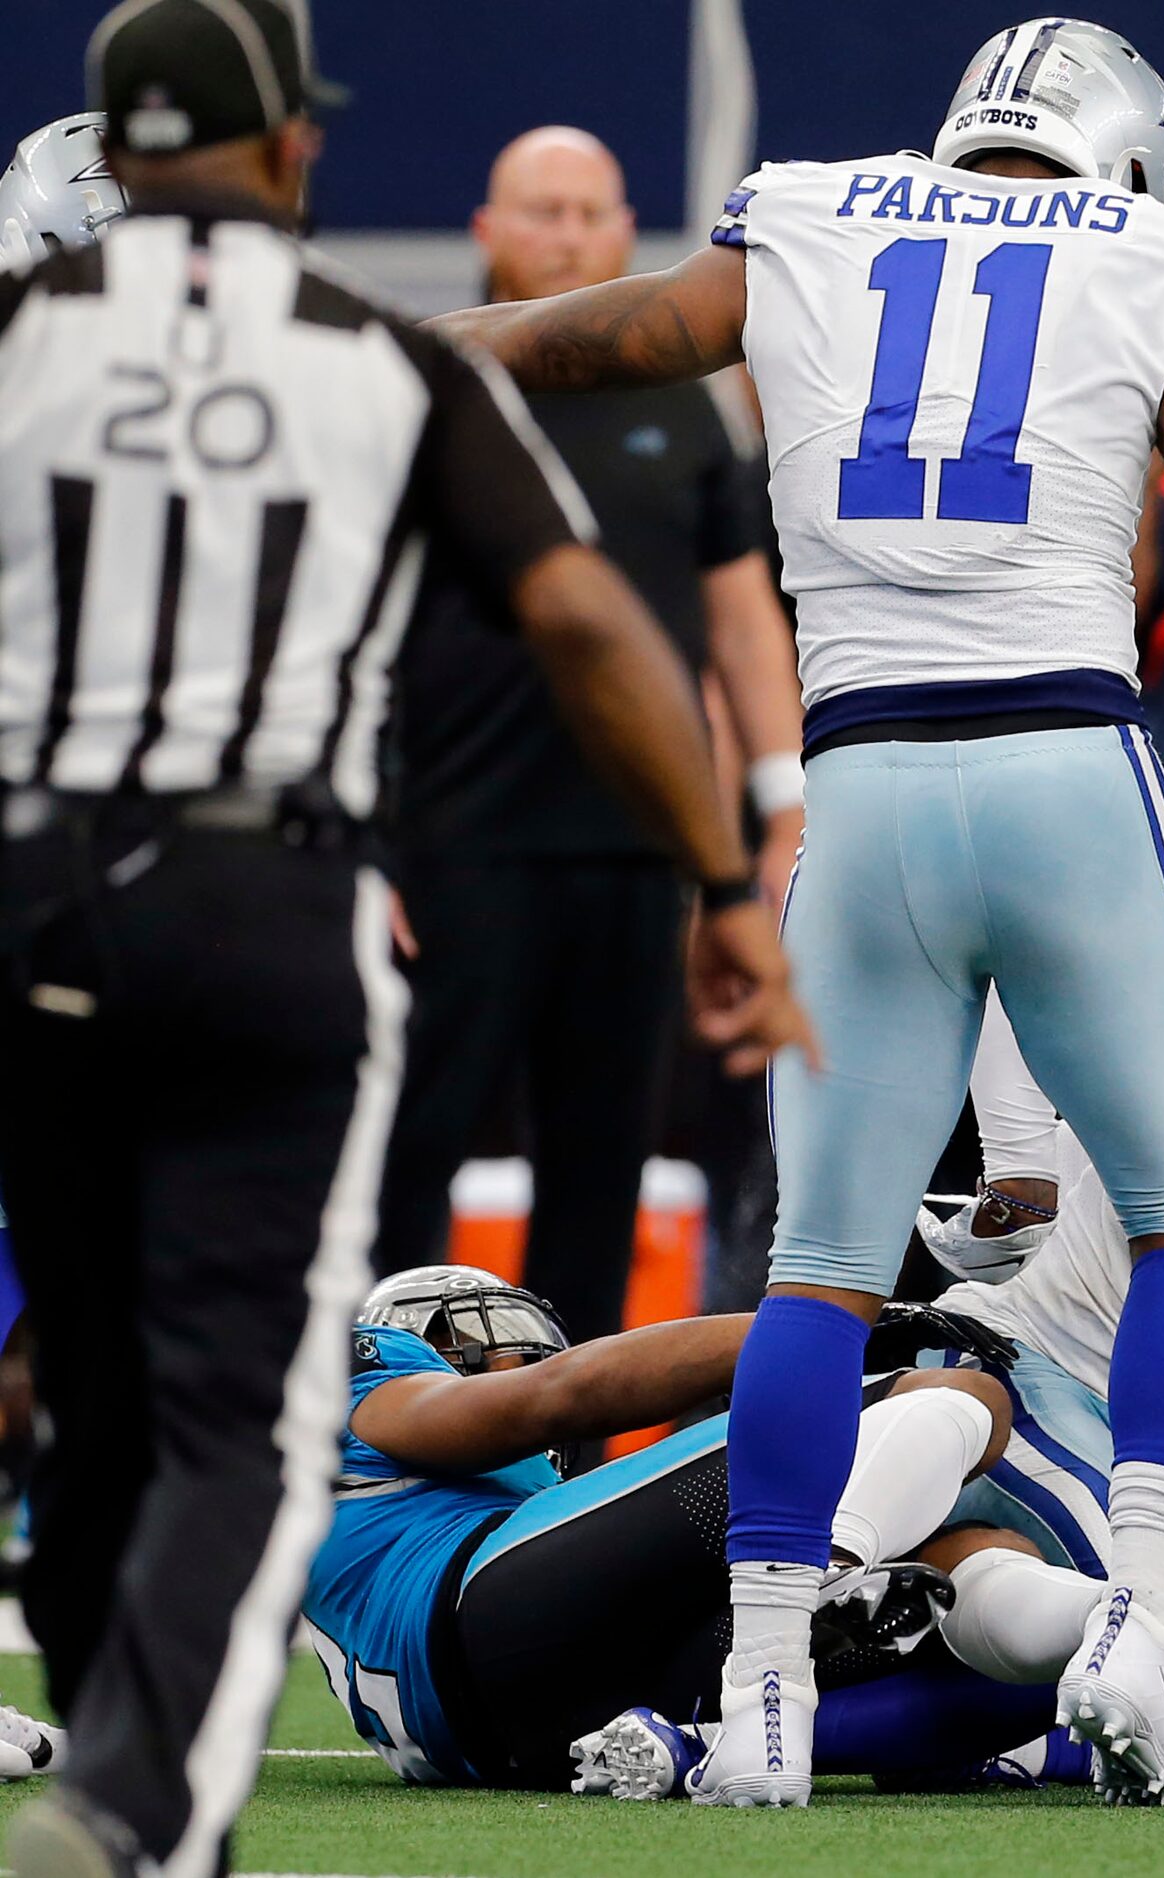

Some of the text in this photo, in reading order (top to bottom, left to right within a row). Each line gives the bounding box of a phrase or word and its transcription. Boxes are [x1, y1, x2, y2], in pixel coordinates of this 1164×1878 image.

[955, 108, 1038, 131] COWBOYS
[837, 174, 1134, 233] PARSONS
[103, 366, 278, 470] 20
[837, 238, 1054, 524] 11
